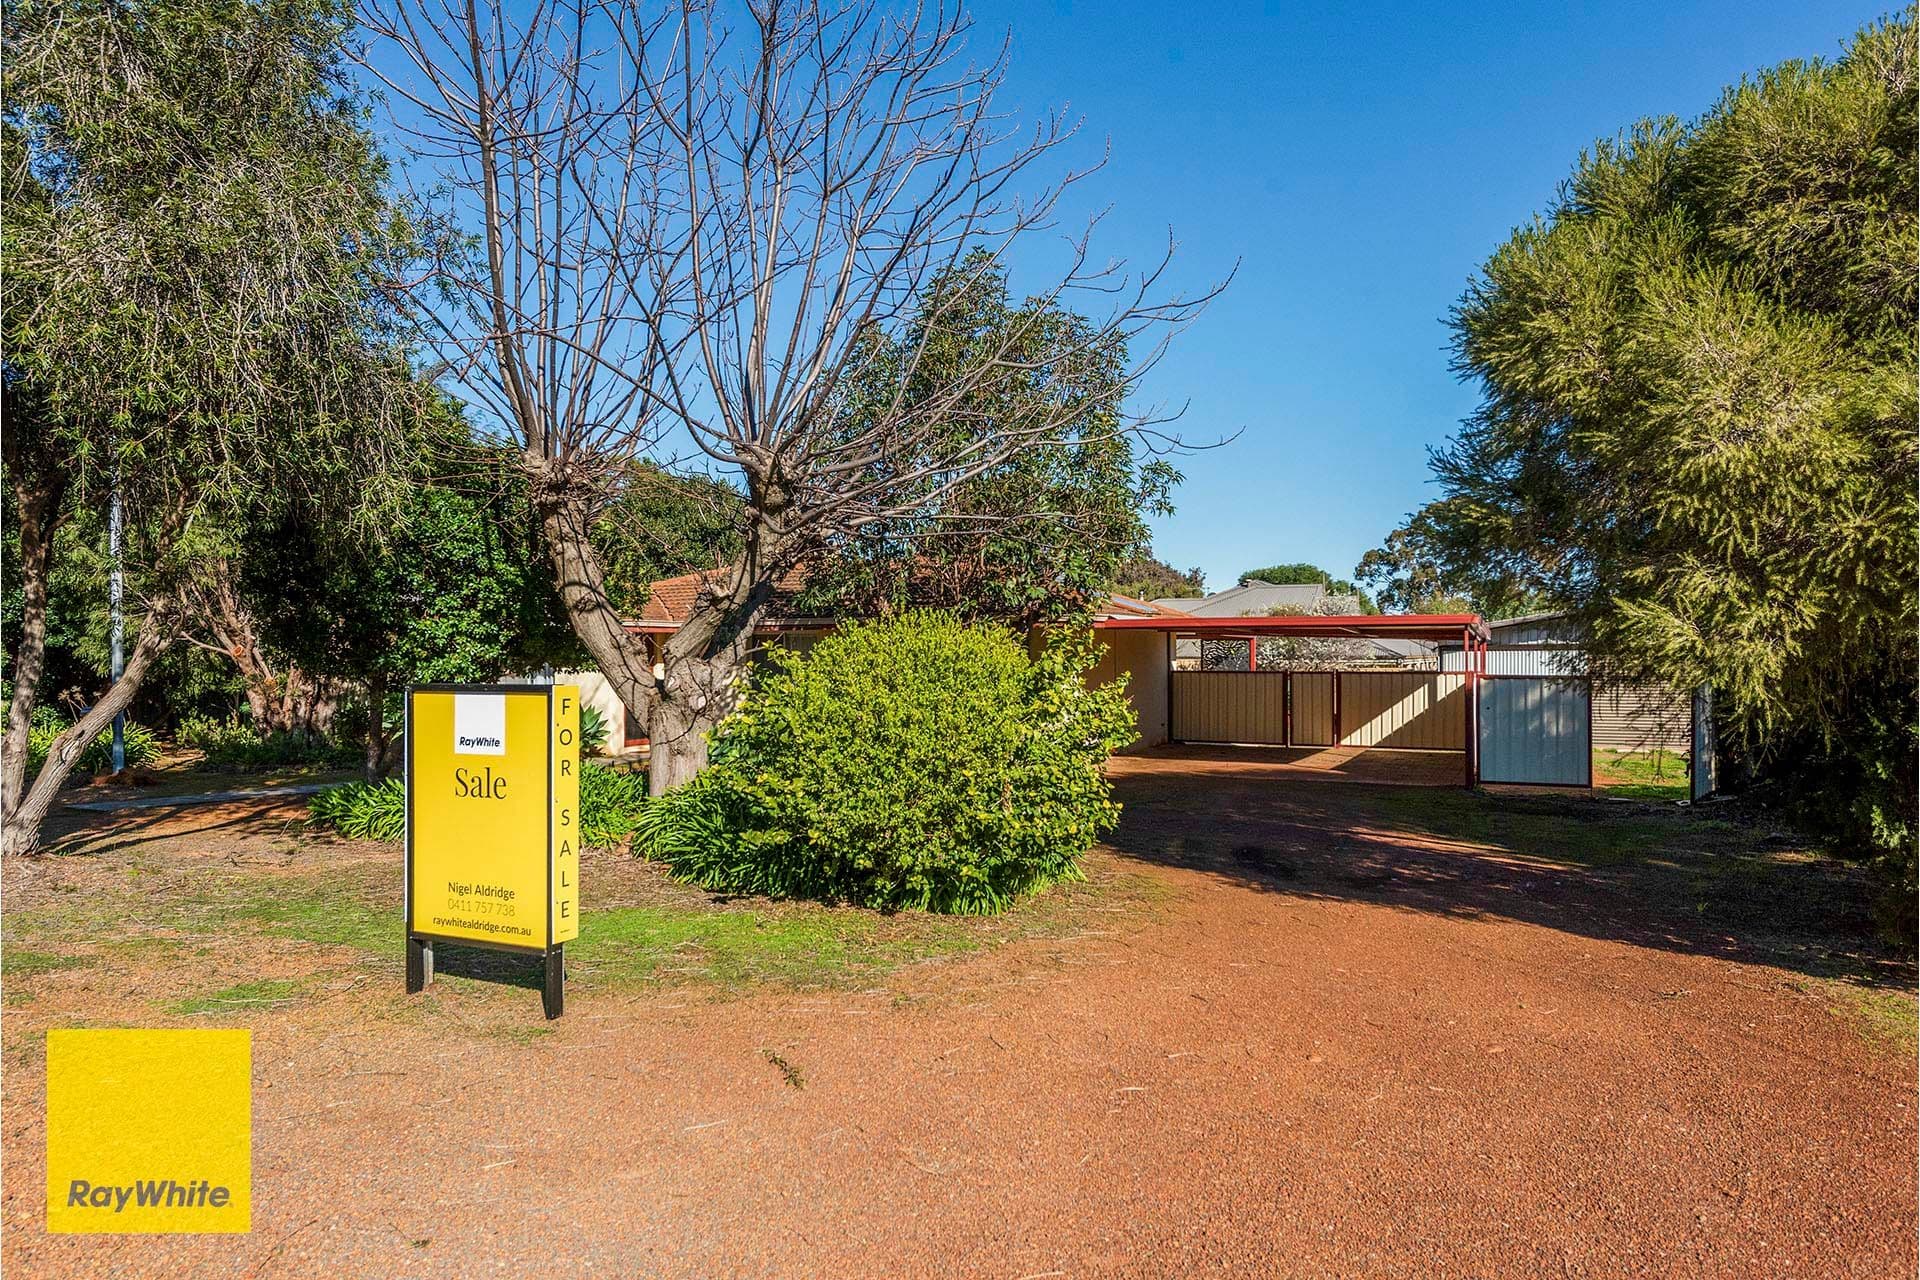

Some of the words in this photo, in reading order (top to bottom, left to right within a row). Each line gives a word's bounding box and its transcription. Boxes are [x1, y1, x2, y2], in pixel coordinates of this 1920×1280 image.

[560, 698, 573, 777] FOR
[455, 767, 507, 800] Sale
[559, 809, 572, 918] SALE
[448, 881, 472, 897] Nigel
[474, 884, 516, 900] Aldridge
[448, 898, 471, 912] 0411
[475, 900, 495, 914] 757
[496, 903, 516, 917] 738
[432, 915, 532, 937] raywhitealdridge.com.au
